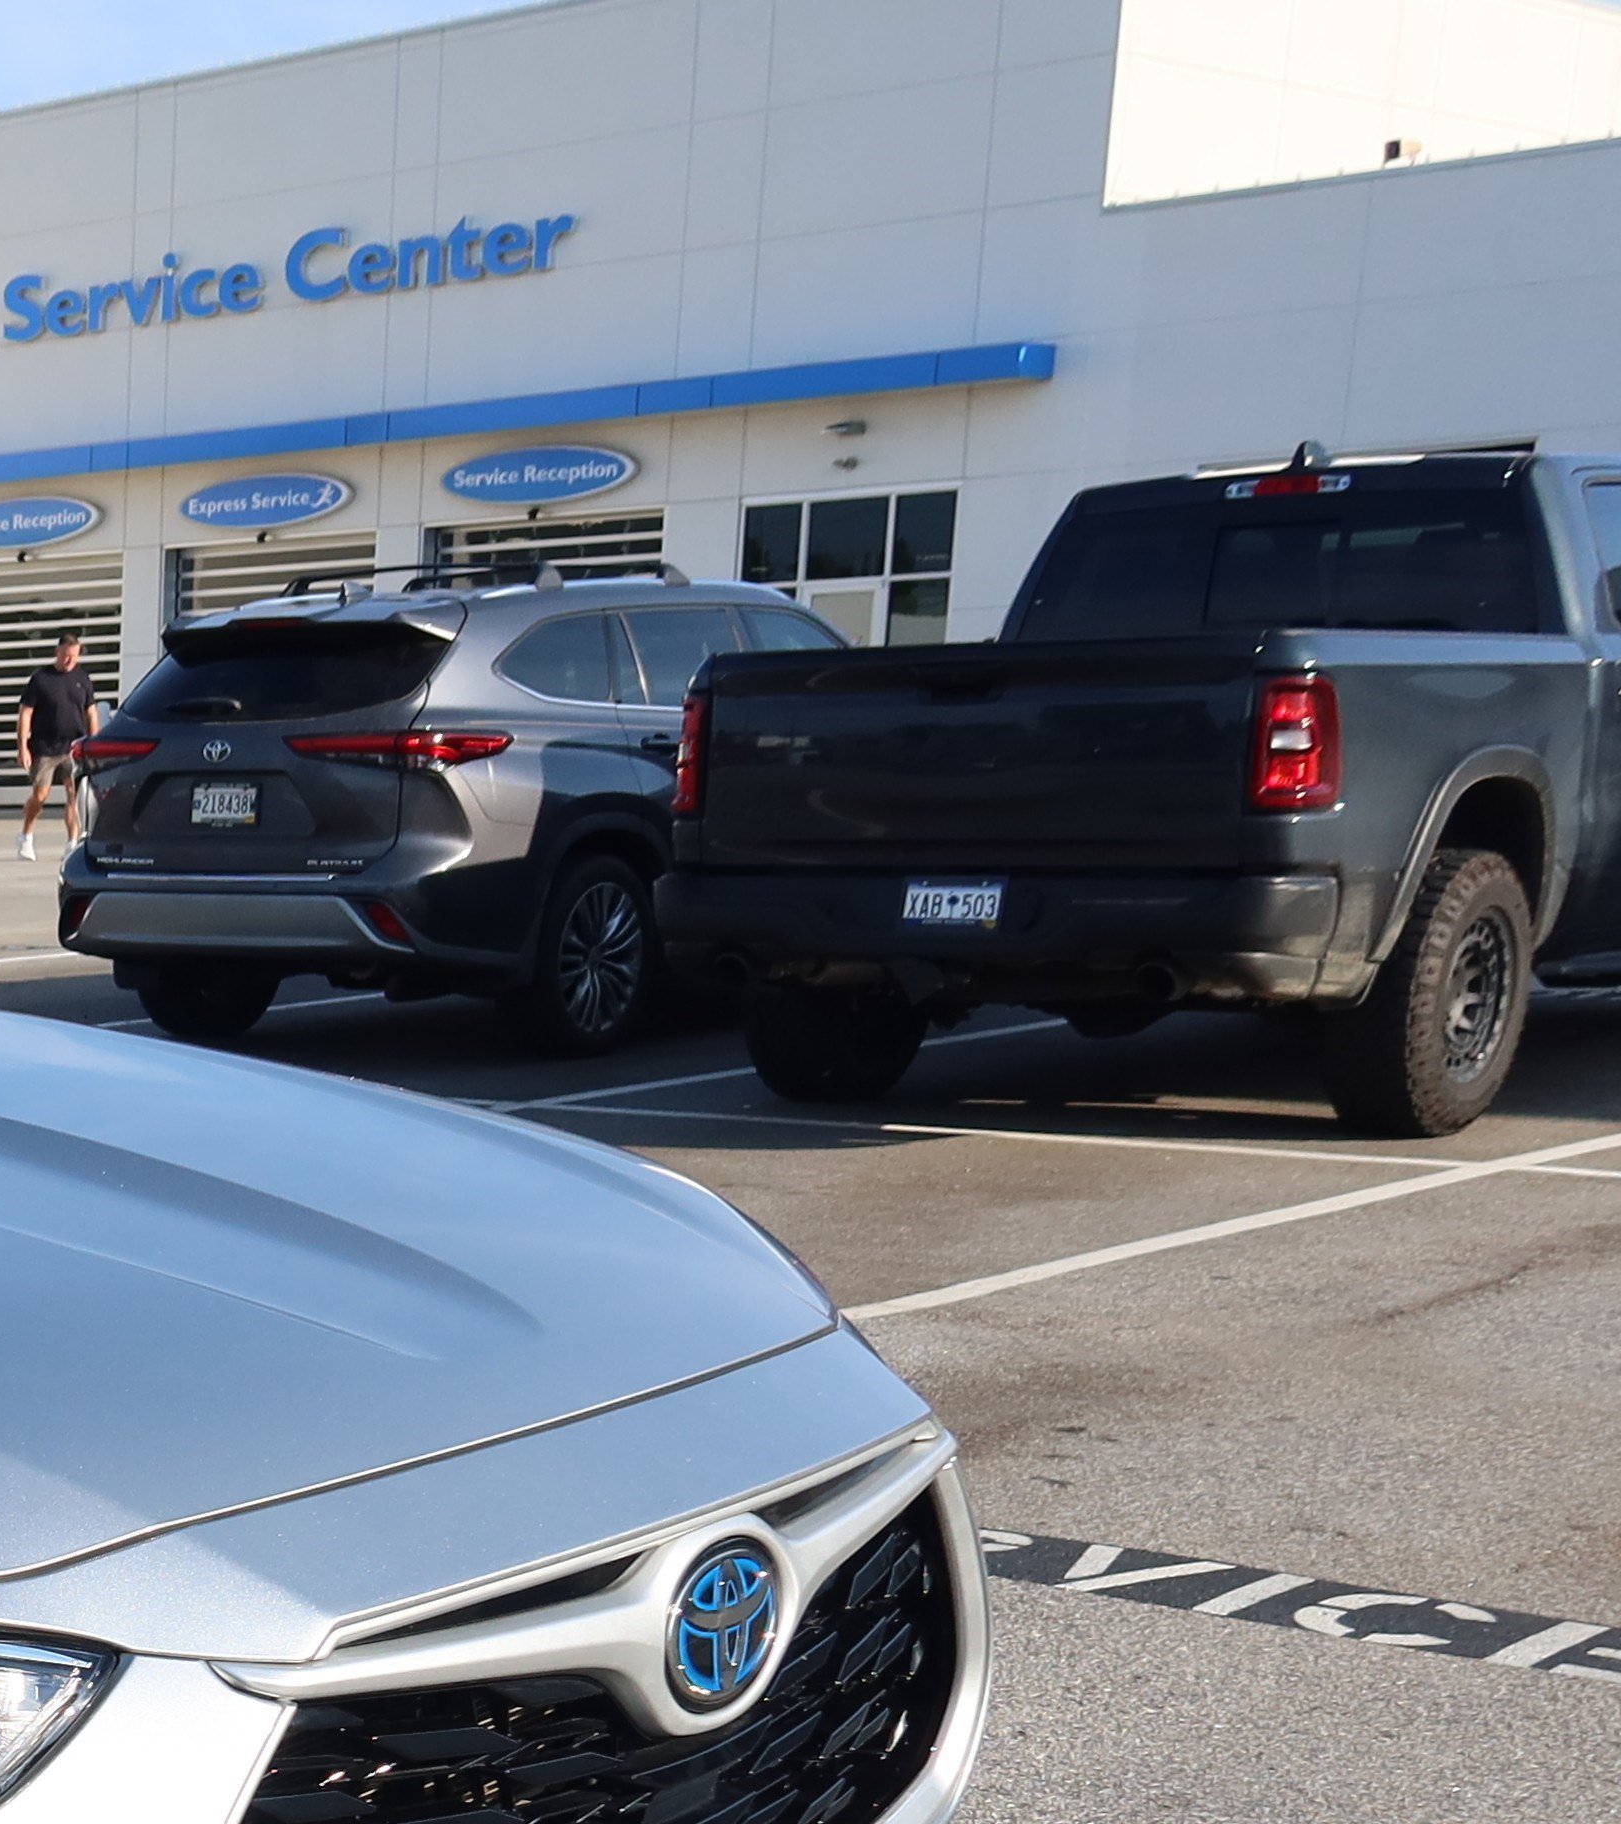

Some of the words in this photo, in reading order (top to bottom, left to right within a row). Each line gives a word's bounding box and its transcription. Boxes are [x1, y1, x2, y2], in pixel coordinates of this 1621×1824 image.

[2, 252, 262, 343] Service
[284, 213, 578, 302] Center
[453, 467, 519, 488] Service
[523, 460, 618, 485] Reception
[188, 498, 247, 518] Express
[251, 488, 311, 510] Service
[13, 508, 86, 531] Reception
[907, 892, 943, 918] XAB
[961, 893, 997, 918] 503
